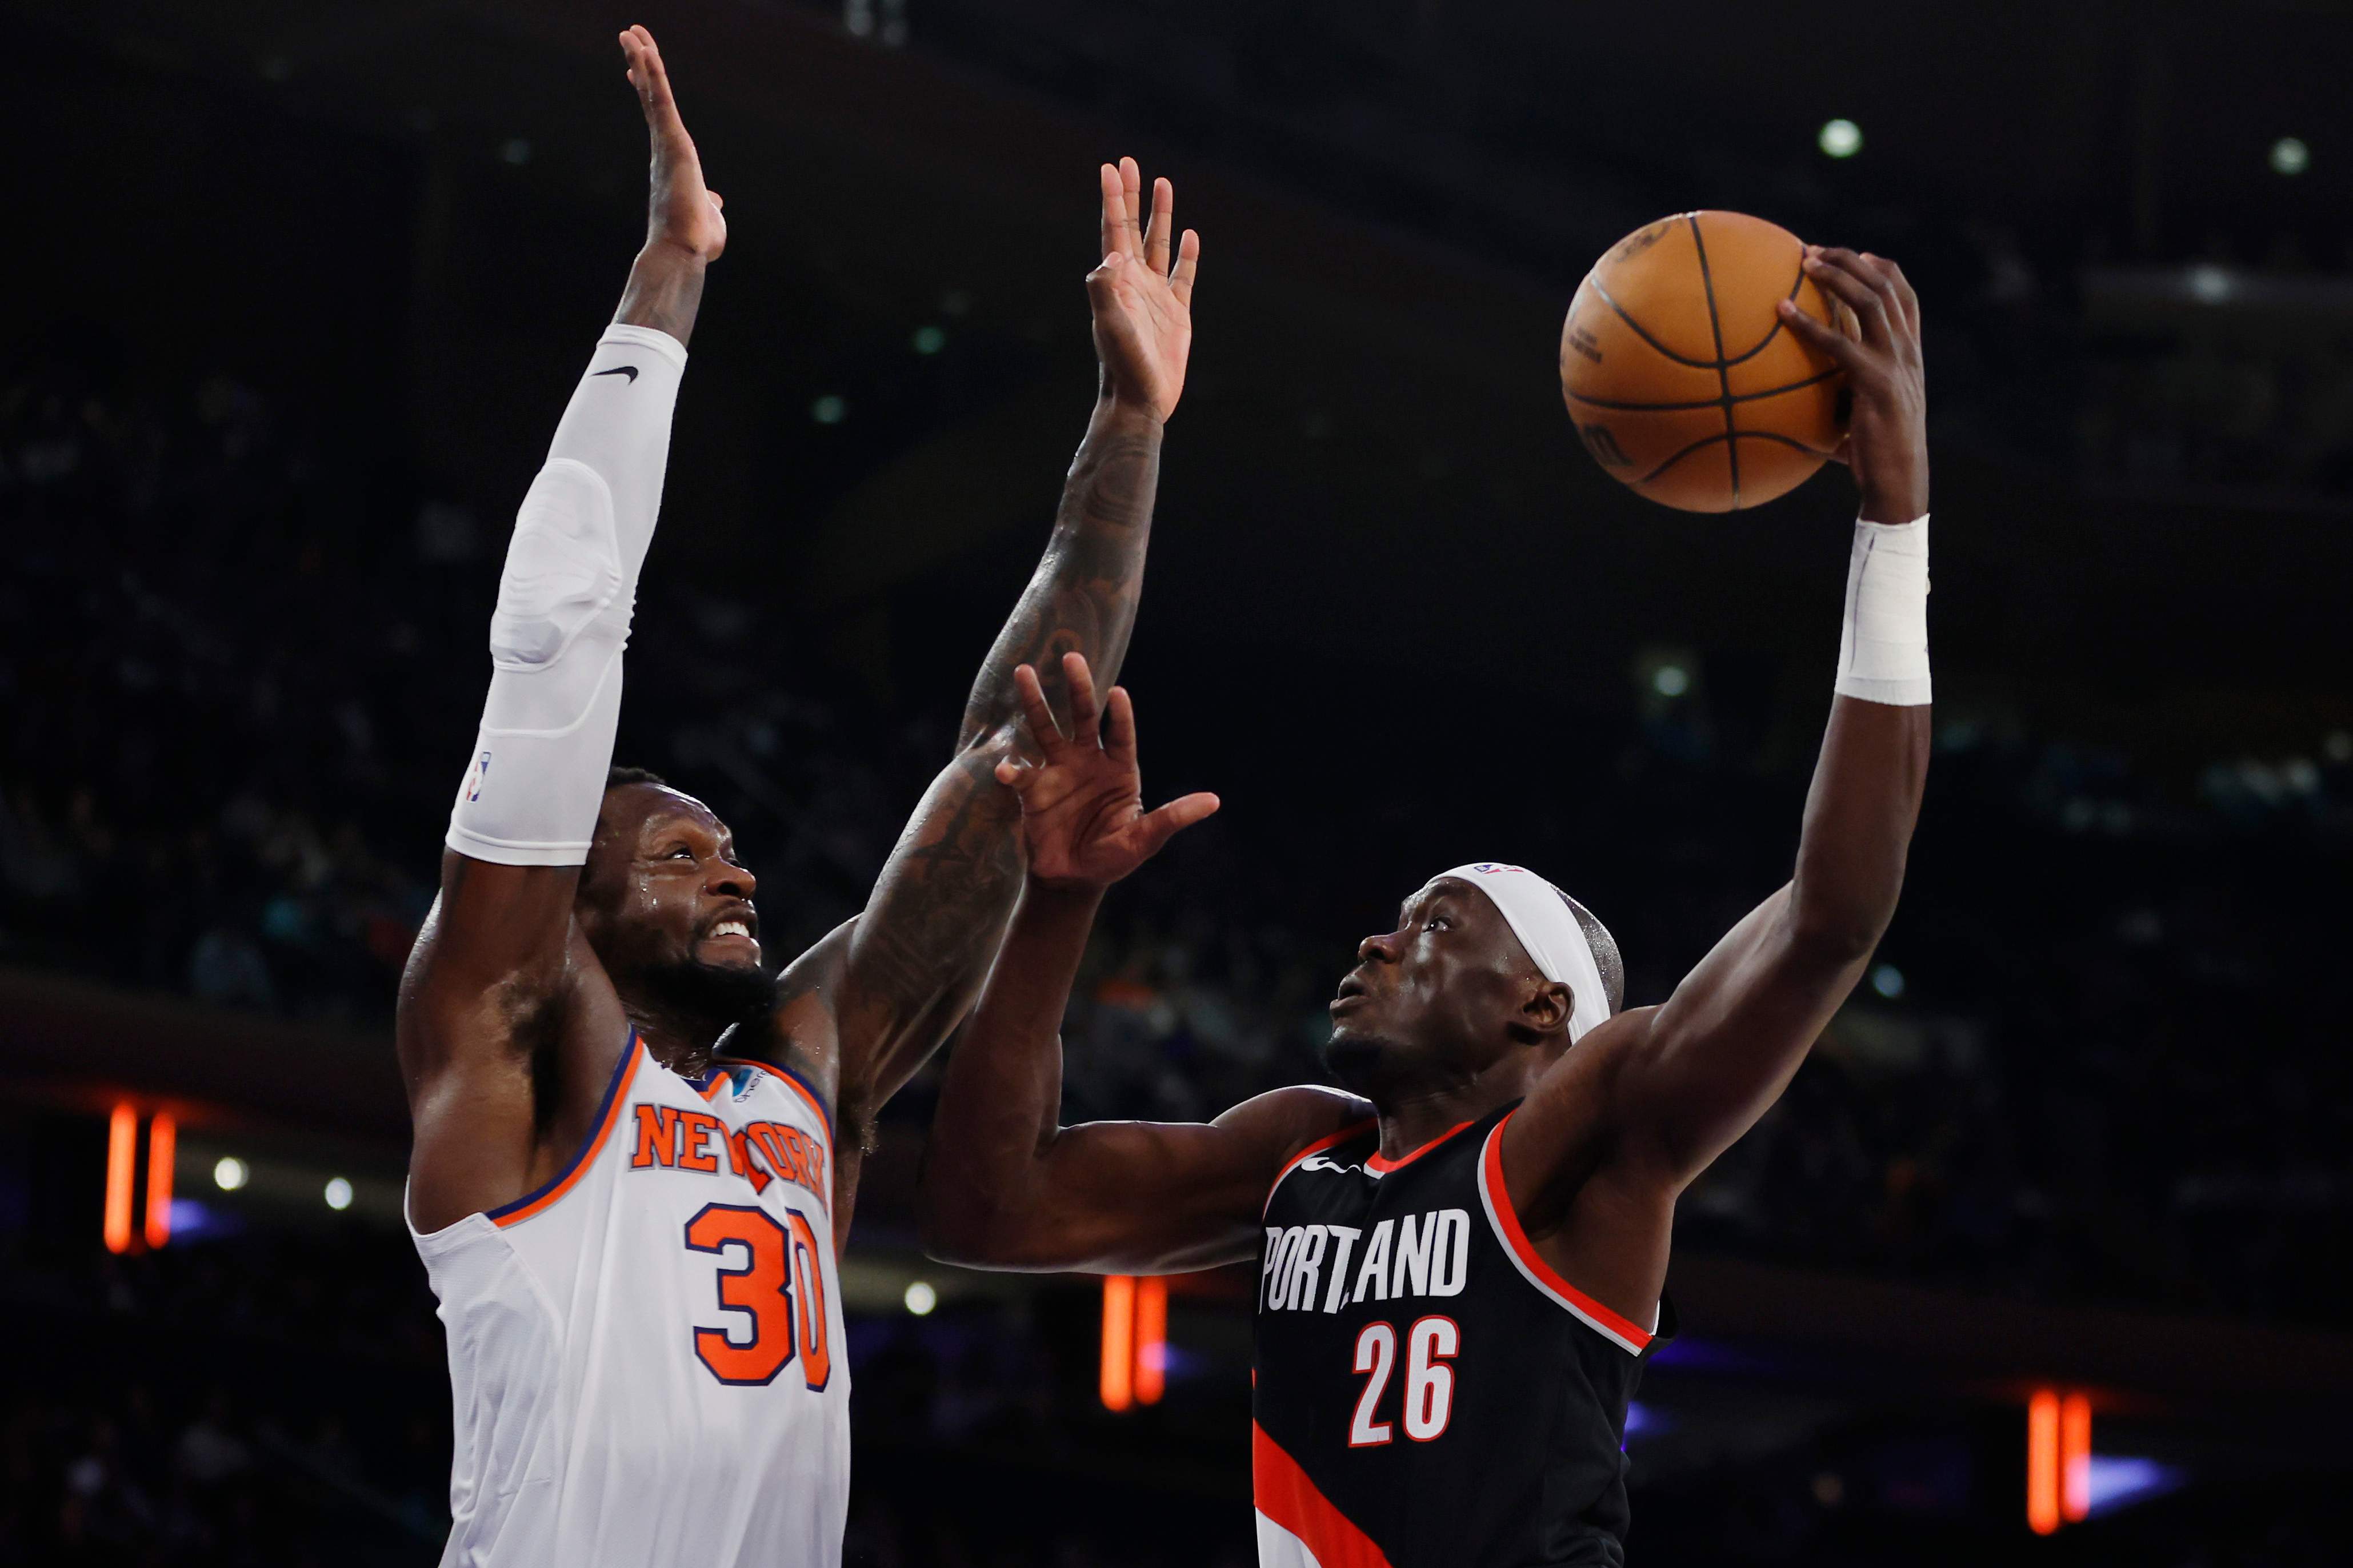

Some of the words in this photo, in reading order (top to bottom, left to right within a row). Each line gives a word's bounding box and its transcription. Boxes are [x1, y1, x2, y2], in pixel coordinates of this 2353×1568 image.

[684, 1202, 830, 1393] 30
[1259, 1208, 1470, 1314] PORTAND
[1348, 1314, 1460, 1448] 26
